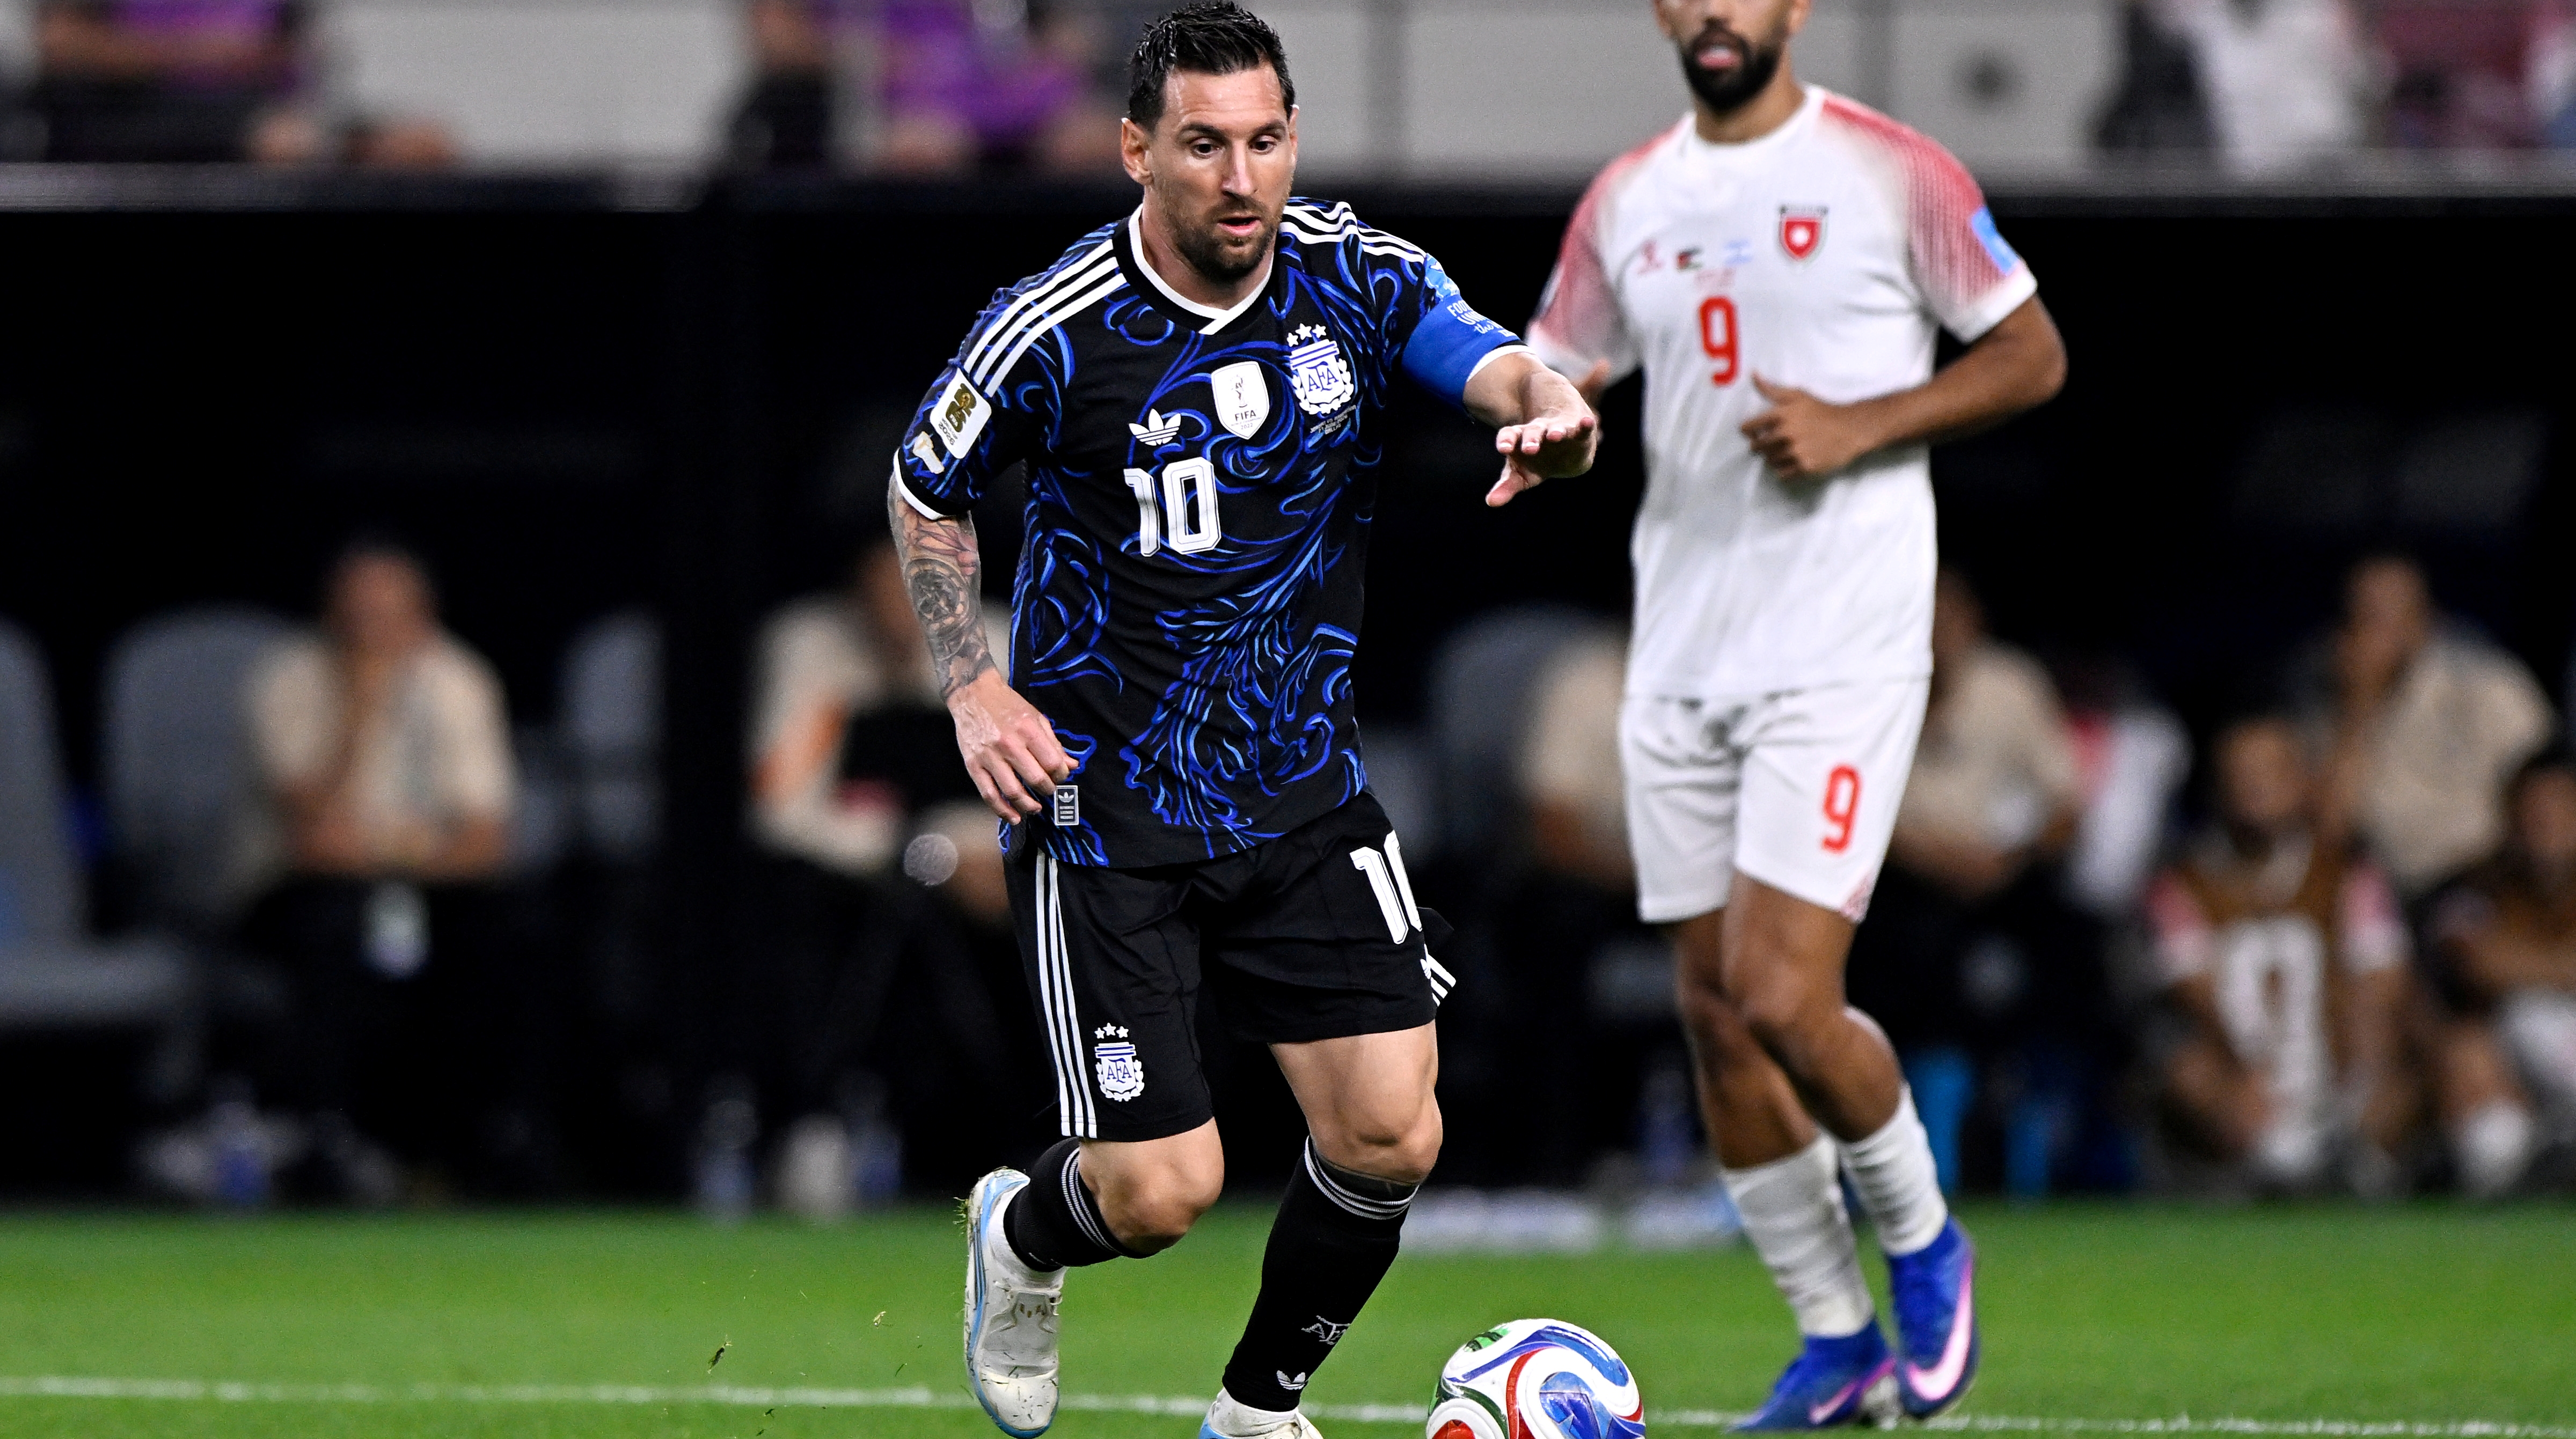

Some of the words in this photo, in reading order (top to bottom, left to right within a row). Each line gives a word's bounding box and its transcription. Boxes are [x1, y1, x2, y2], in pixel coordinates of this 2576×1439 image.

[1699, 297, 1738, 386] 9
[1306, 361, 1339, 392] AFA
[1235, 410, 1256, 421] FIFA
[939, 423, 955, 446] 2026
[1123, 457, 1221, 557] 10
[1821, 764, 1862, 851] 9
[1107, 1058, 1132, 1083] AFA
